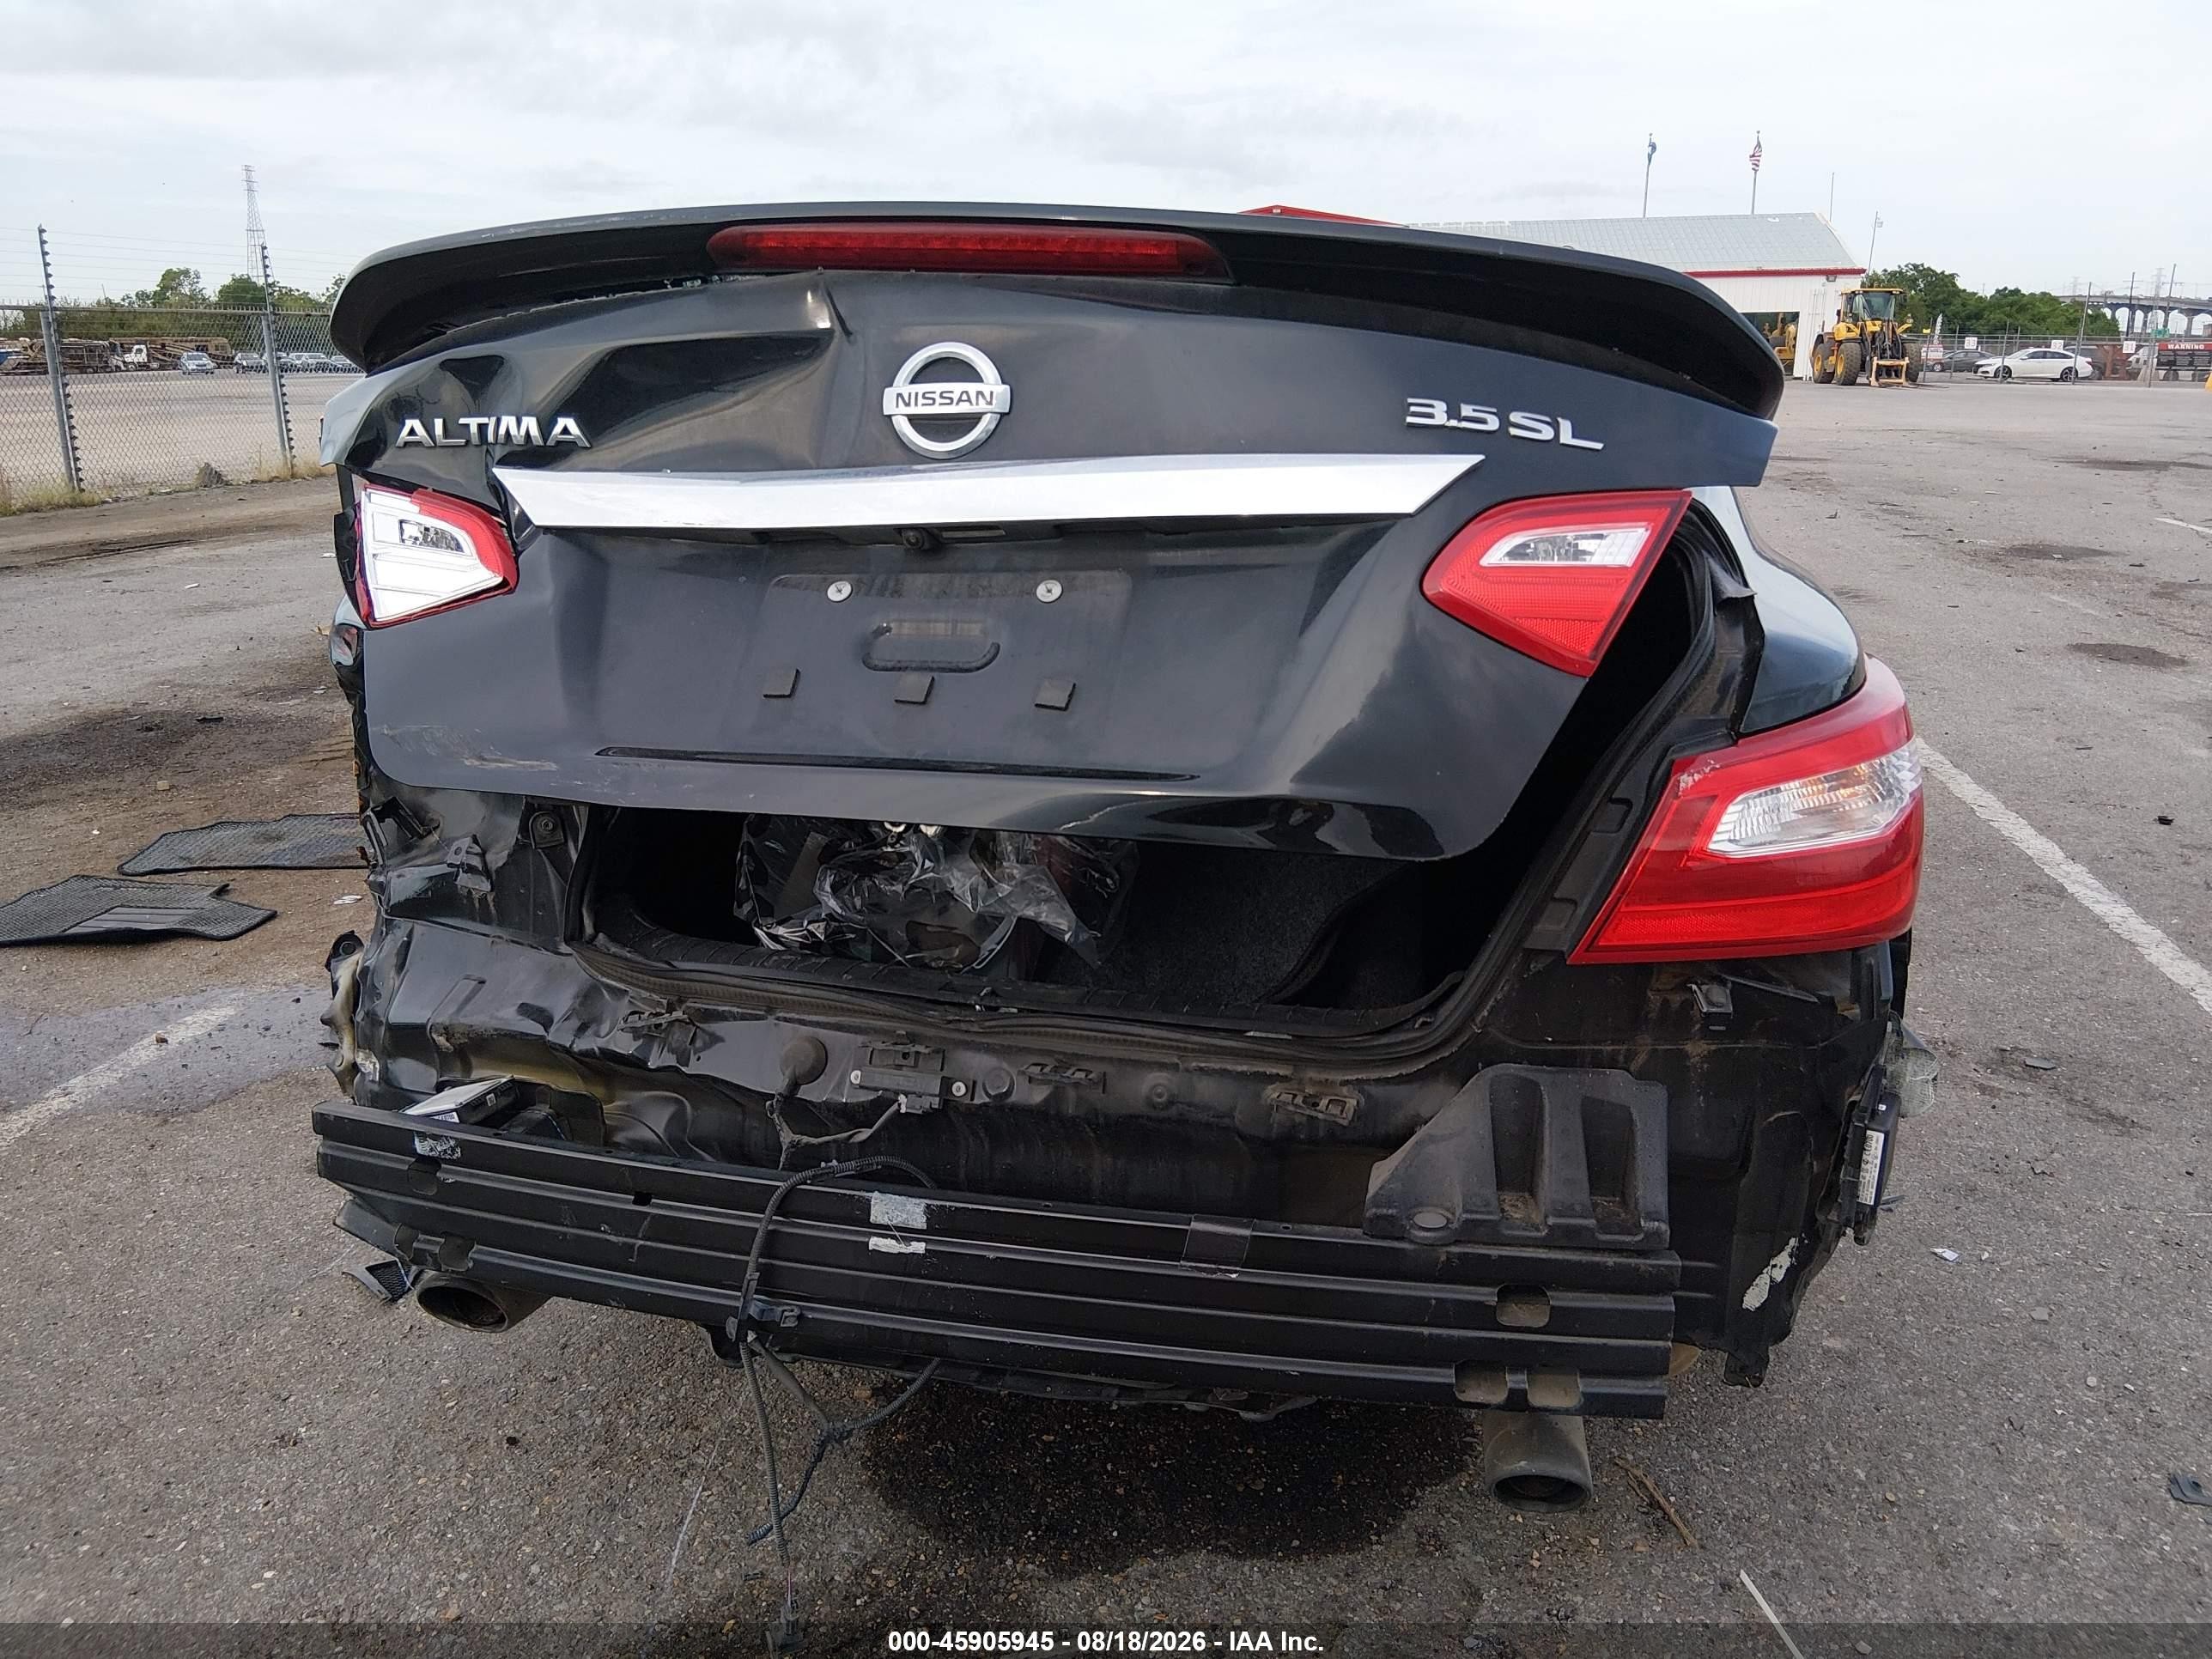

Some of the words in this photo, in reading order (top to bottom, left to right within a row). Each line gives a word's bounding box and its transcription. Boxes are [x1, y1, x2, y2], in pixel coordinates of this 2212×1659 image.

[896, 390, 994, 408] NISSAN
[396, 416, 591, 447] ALTIMA
[1405, 398, 1499, 432] 3.5
[1508, 411, 1604, 451] SL
